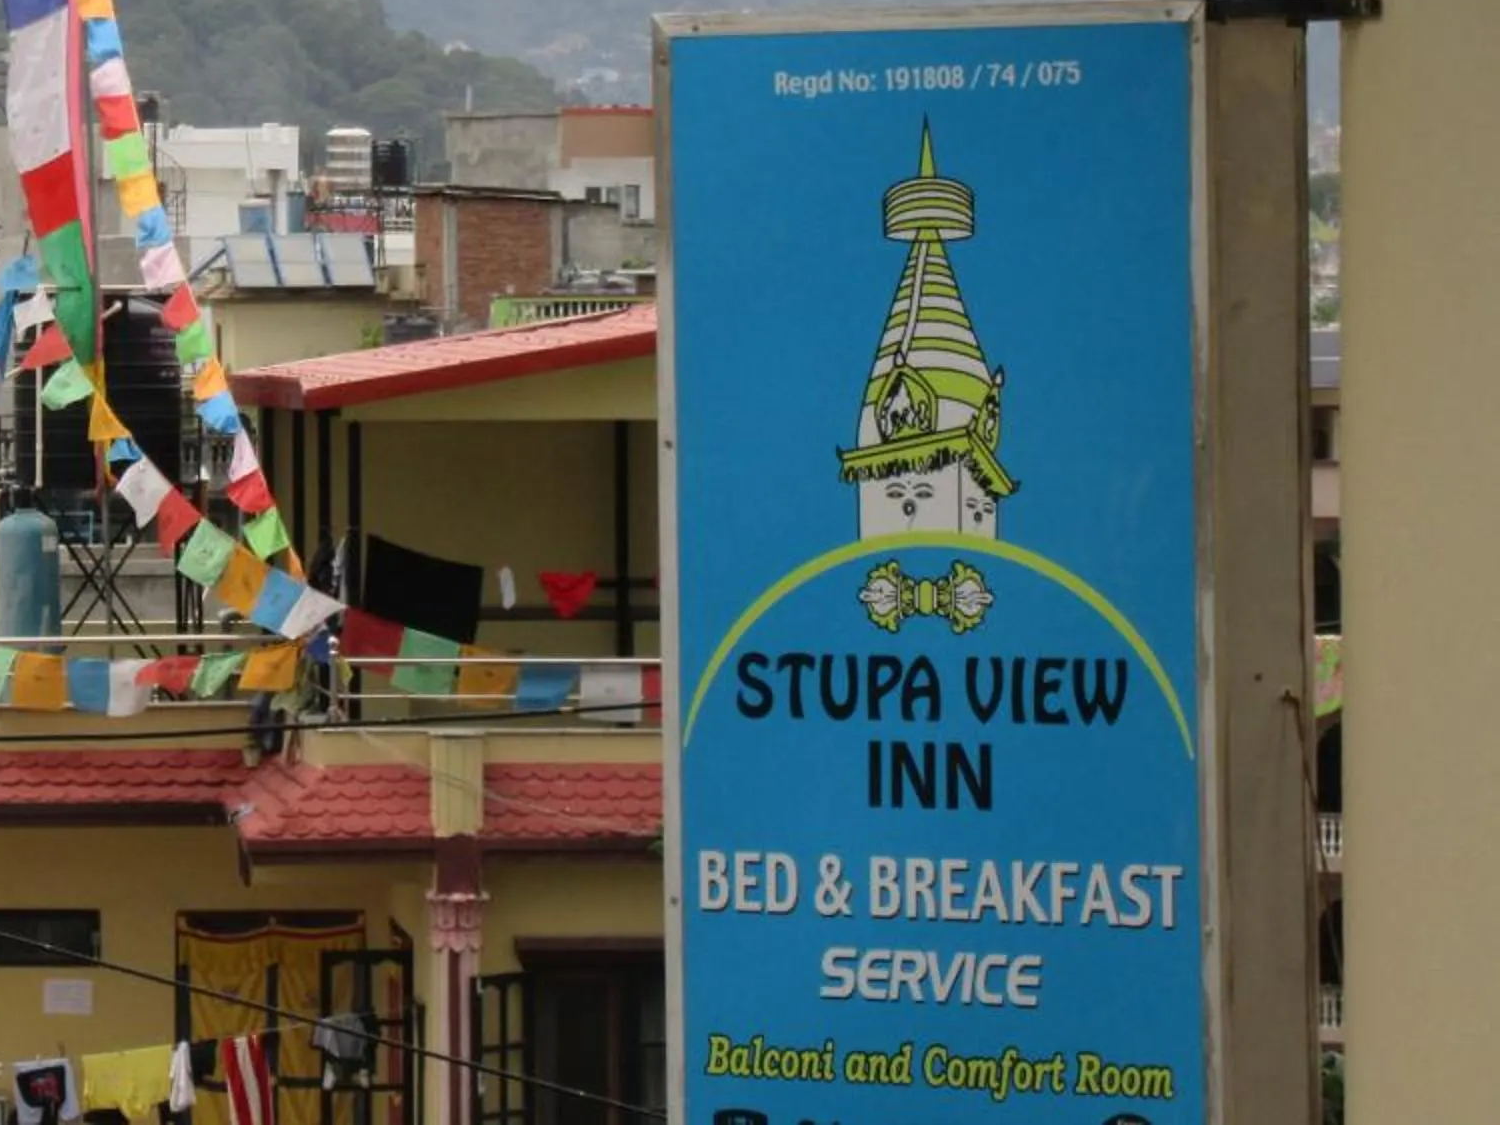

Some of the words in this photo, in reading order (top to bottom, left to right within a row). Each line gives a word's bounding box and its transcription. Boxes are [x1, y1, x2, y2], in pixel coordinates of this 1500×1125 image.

[774, 70, 833, 97] Regd
[838, 69, 876, 92] No:
[884, 65, 965, 91] 191808
[988, 63, 1016, 87] 74
[1038, 61, 1080, 85] 075
[736, 652, 941, 722] STUPA
[965, 656, 1129, 726] VIEW
[868, 740, 993, 811] INN
[699, 850, 798, 914] BED
[814, 854, 852, 917] &
[869, 856, 1183, 929] BREAKFAST
[819, 946, 1043, 1007] SERVICE
[706, 1034, 834, 1083] Balconi
[844, 1042, 912, 1086] and
[922, 1045, 1066, 1102] Comfort
[1074, 1053, 1175, 1100] Room
